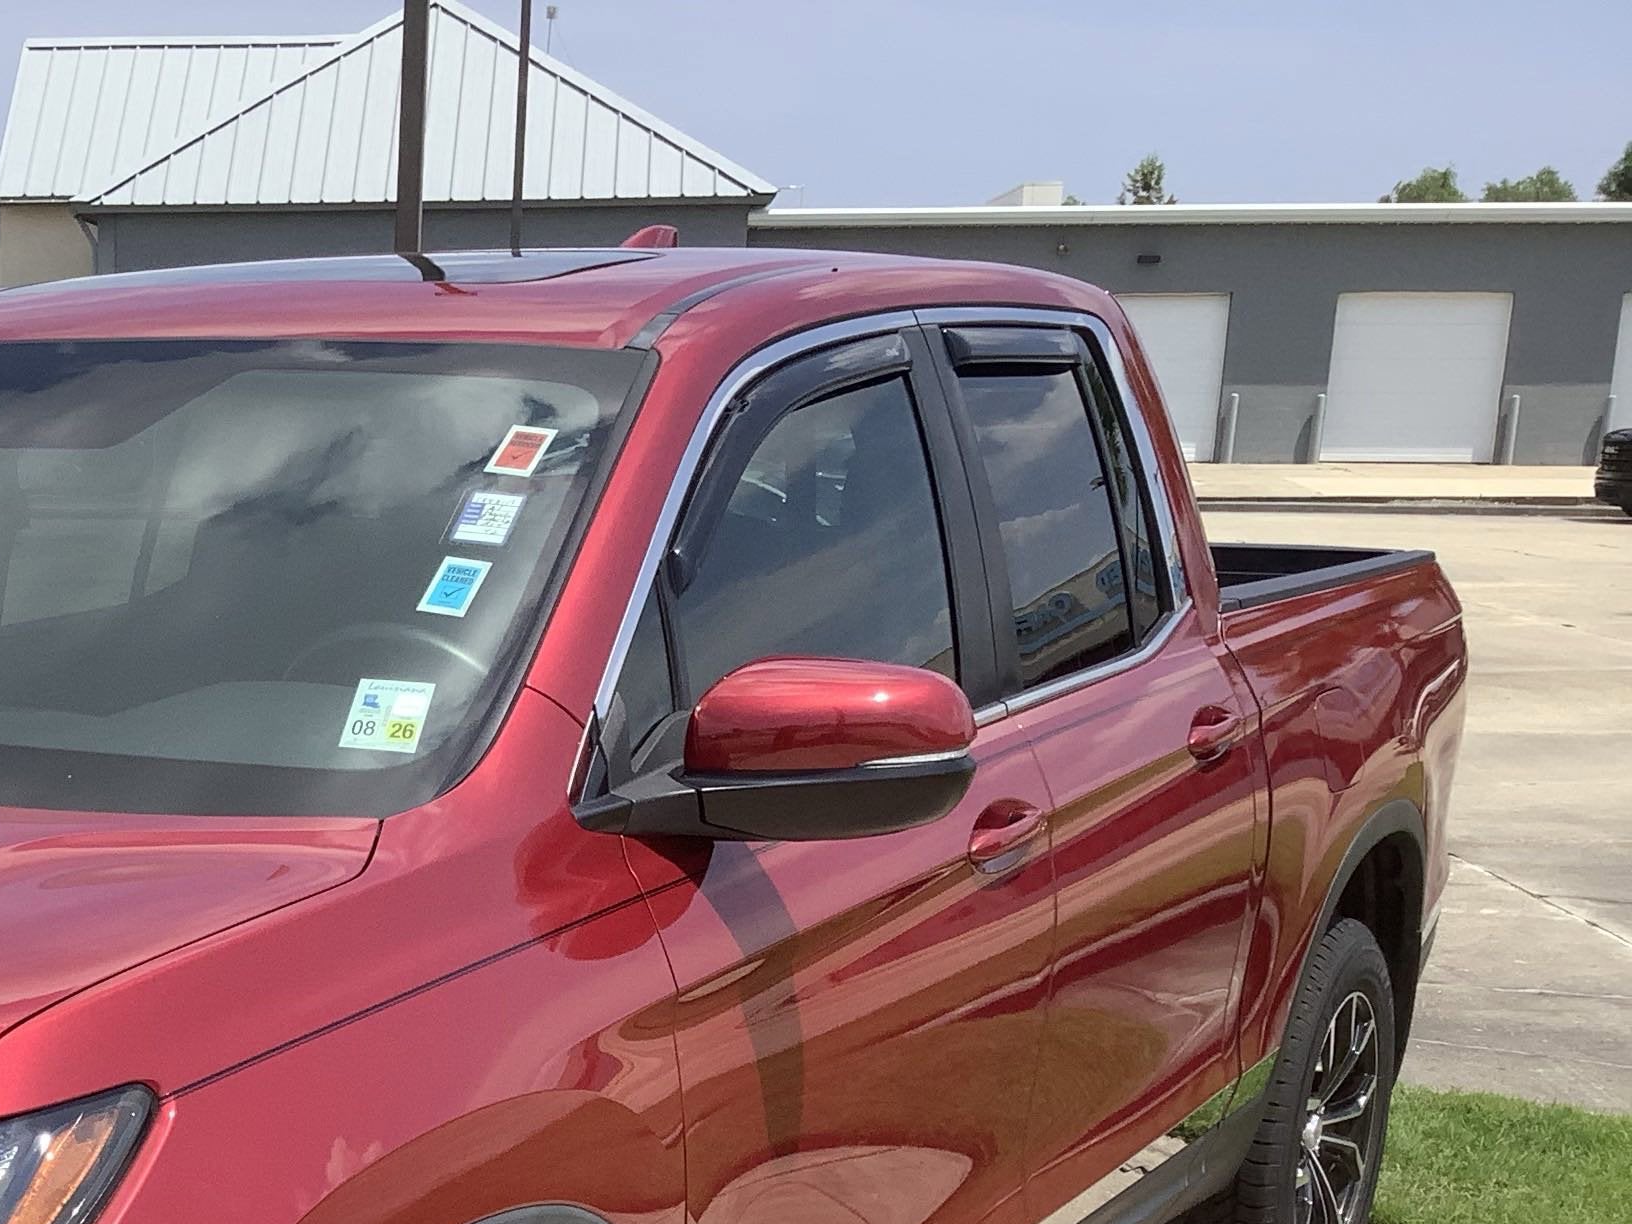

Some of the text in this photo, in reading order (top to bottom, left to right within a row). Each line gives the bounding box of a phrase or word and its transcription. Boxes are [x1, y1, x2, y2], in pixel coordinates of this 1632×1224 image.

[446, 566, 478, 577] VEHICLE
[368, 682, 426, 693] Louisiana
[351, 719, 415, 739] 08 26
